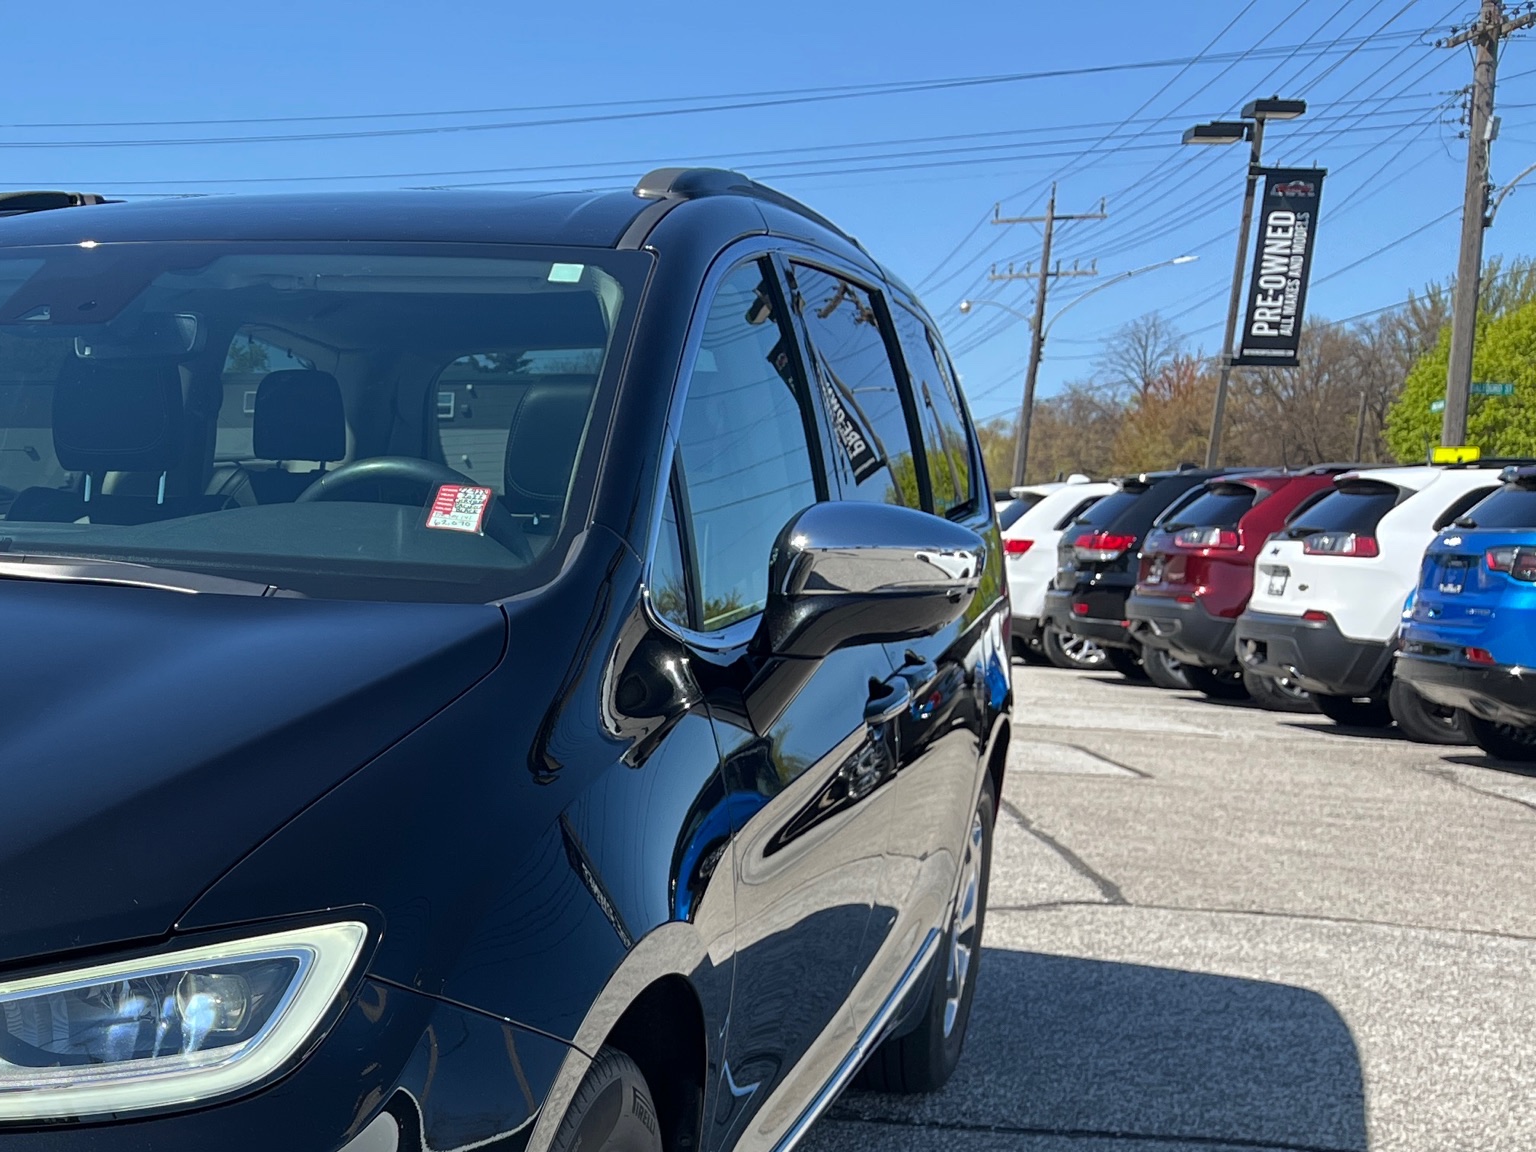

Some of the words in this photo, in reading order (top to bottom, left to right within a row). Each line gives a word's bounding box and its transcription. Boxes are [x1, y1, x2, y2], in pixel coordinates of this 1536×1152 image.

[1292, 212, 1310, 254] MODELS
[1251, 211, 1296, 337] PRE-OWNED
[1288, 255, 1304, 278] AND
[1282, 279, 1301, 316] MAKES
[1279, 316, 1295, 336] ALL
[632, 1086, 656, 1136] PIRELLI
